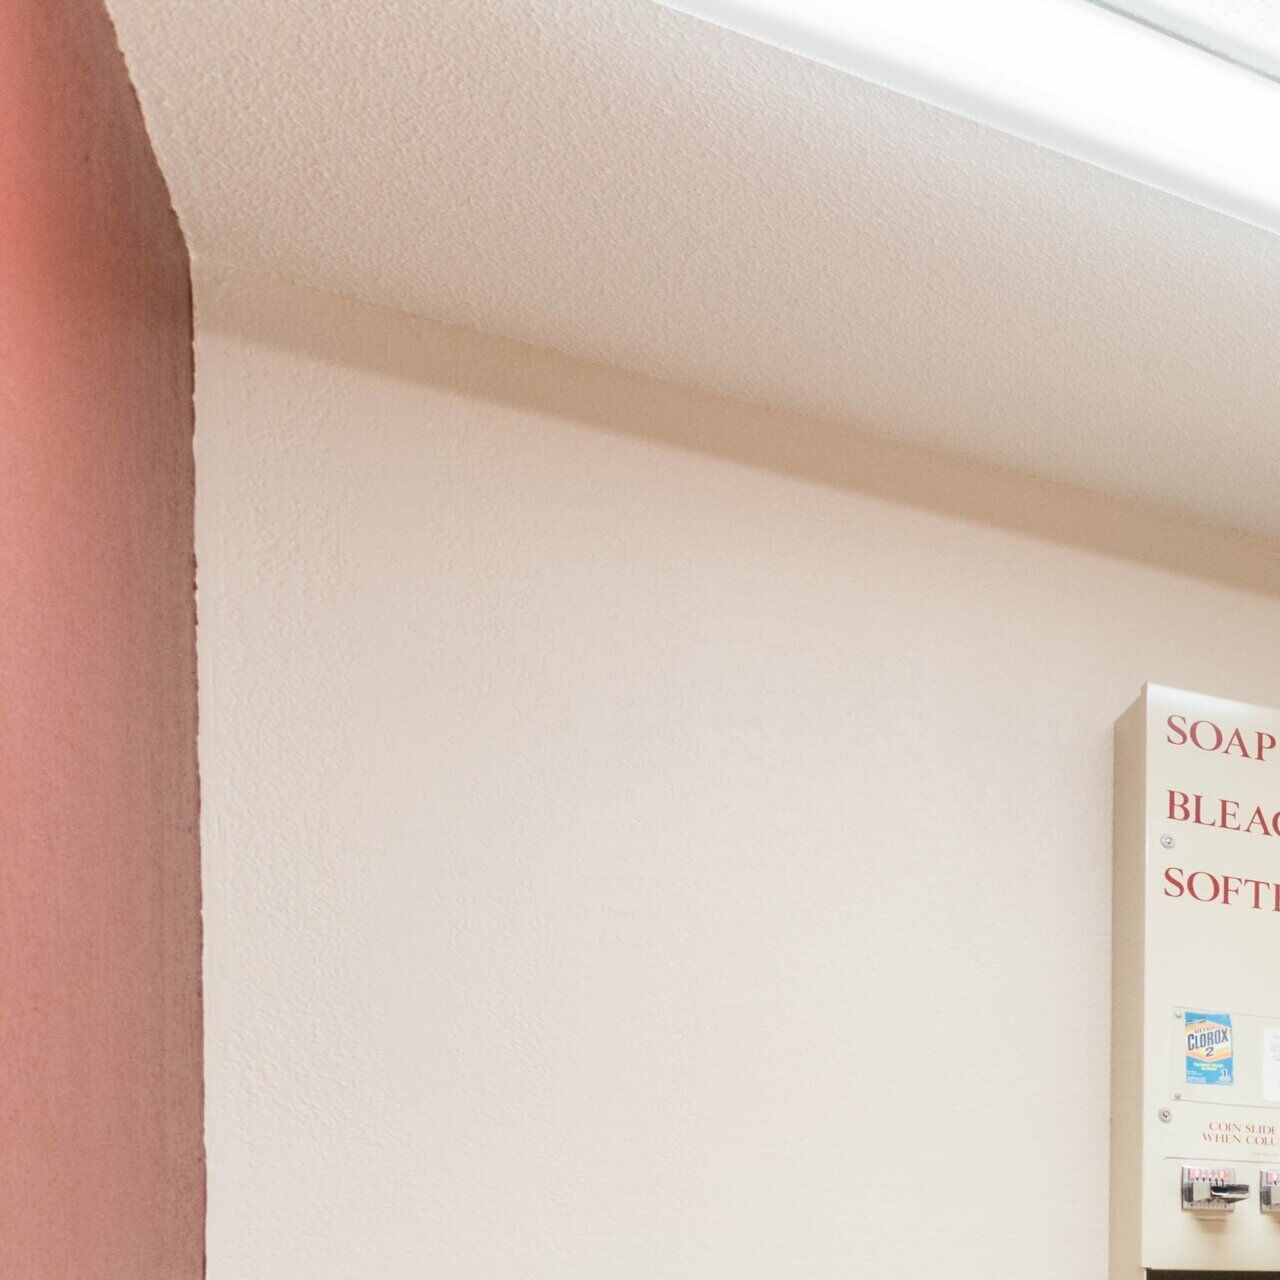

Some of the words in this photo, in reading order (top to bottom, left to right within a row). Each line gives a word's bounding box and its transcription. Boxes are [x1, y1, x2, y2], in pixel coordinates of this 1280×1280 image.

[1166, 714, 1277, 762] SOAP
[1187, 1028, 1229, 1051] CLOROX
[1205, 1046, 1215, 1057] 2
[1209, 1121, 1241, 1132] COIN
[1245, 1123, 1277, 1135] SLIDE
[1202, 1132, 1241, 1144] WHEN
